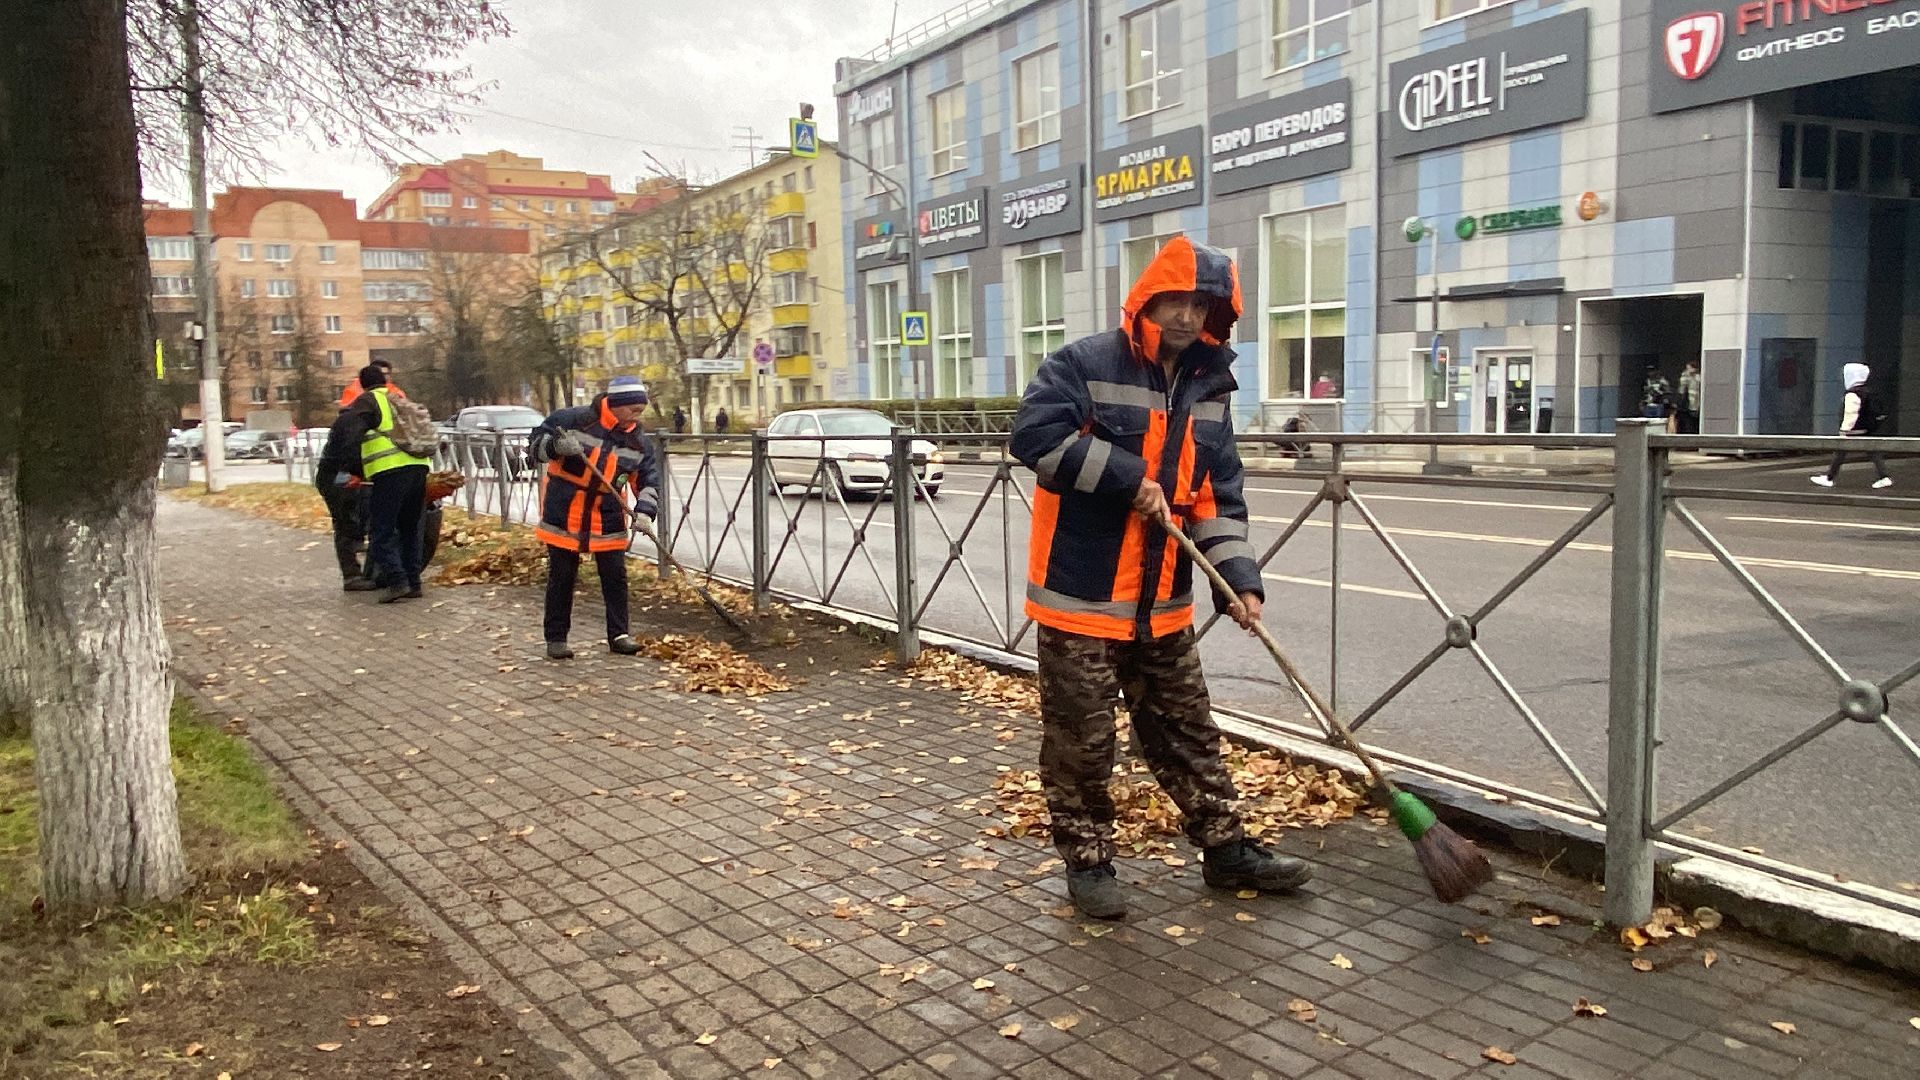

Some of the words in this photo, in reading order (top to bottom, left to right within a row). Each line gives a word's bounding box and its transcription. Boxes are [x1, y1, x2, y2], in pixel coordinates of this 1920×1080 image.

[1736, 26, 1845, 62] ФИТНЕСС
[1867, 10, 1920, 35] БАС
[1211, 127, 1252, 155] БЮРО
[1254, 102, 1346, 143] ПЕРЕВОДОВ
[1095, 154, 1194, 198] ЯРМАРКА
[929, 199, 979, 232] ЦВЕТЫ
[1002, 193, 1067, 229] ЭМЗАВР
